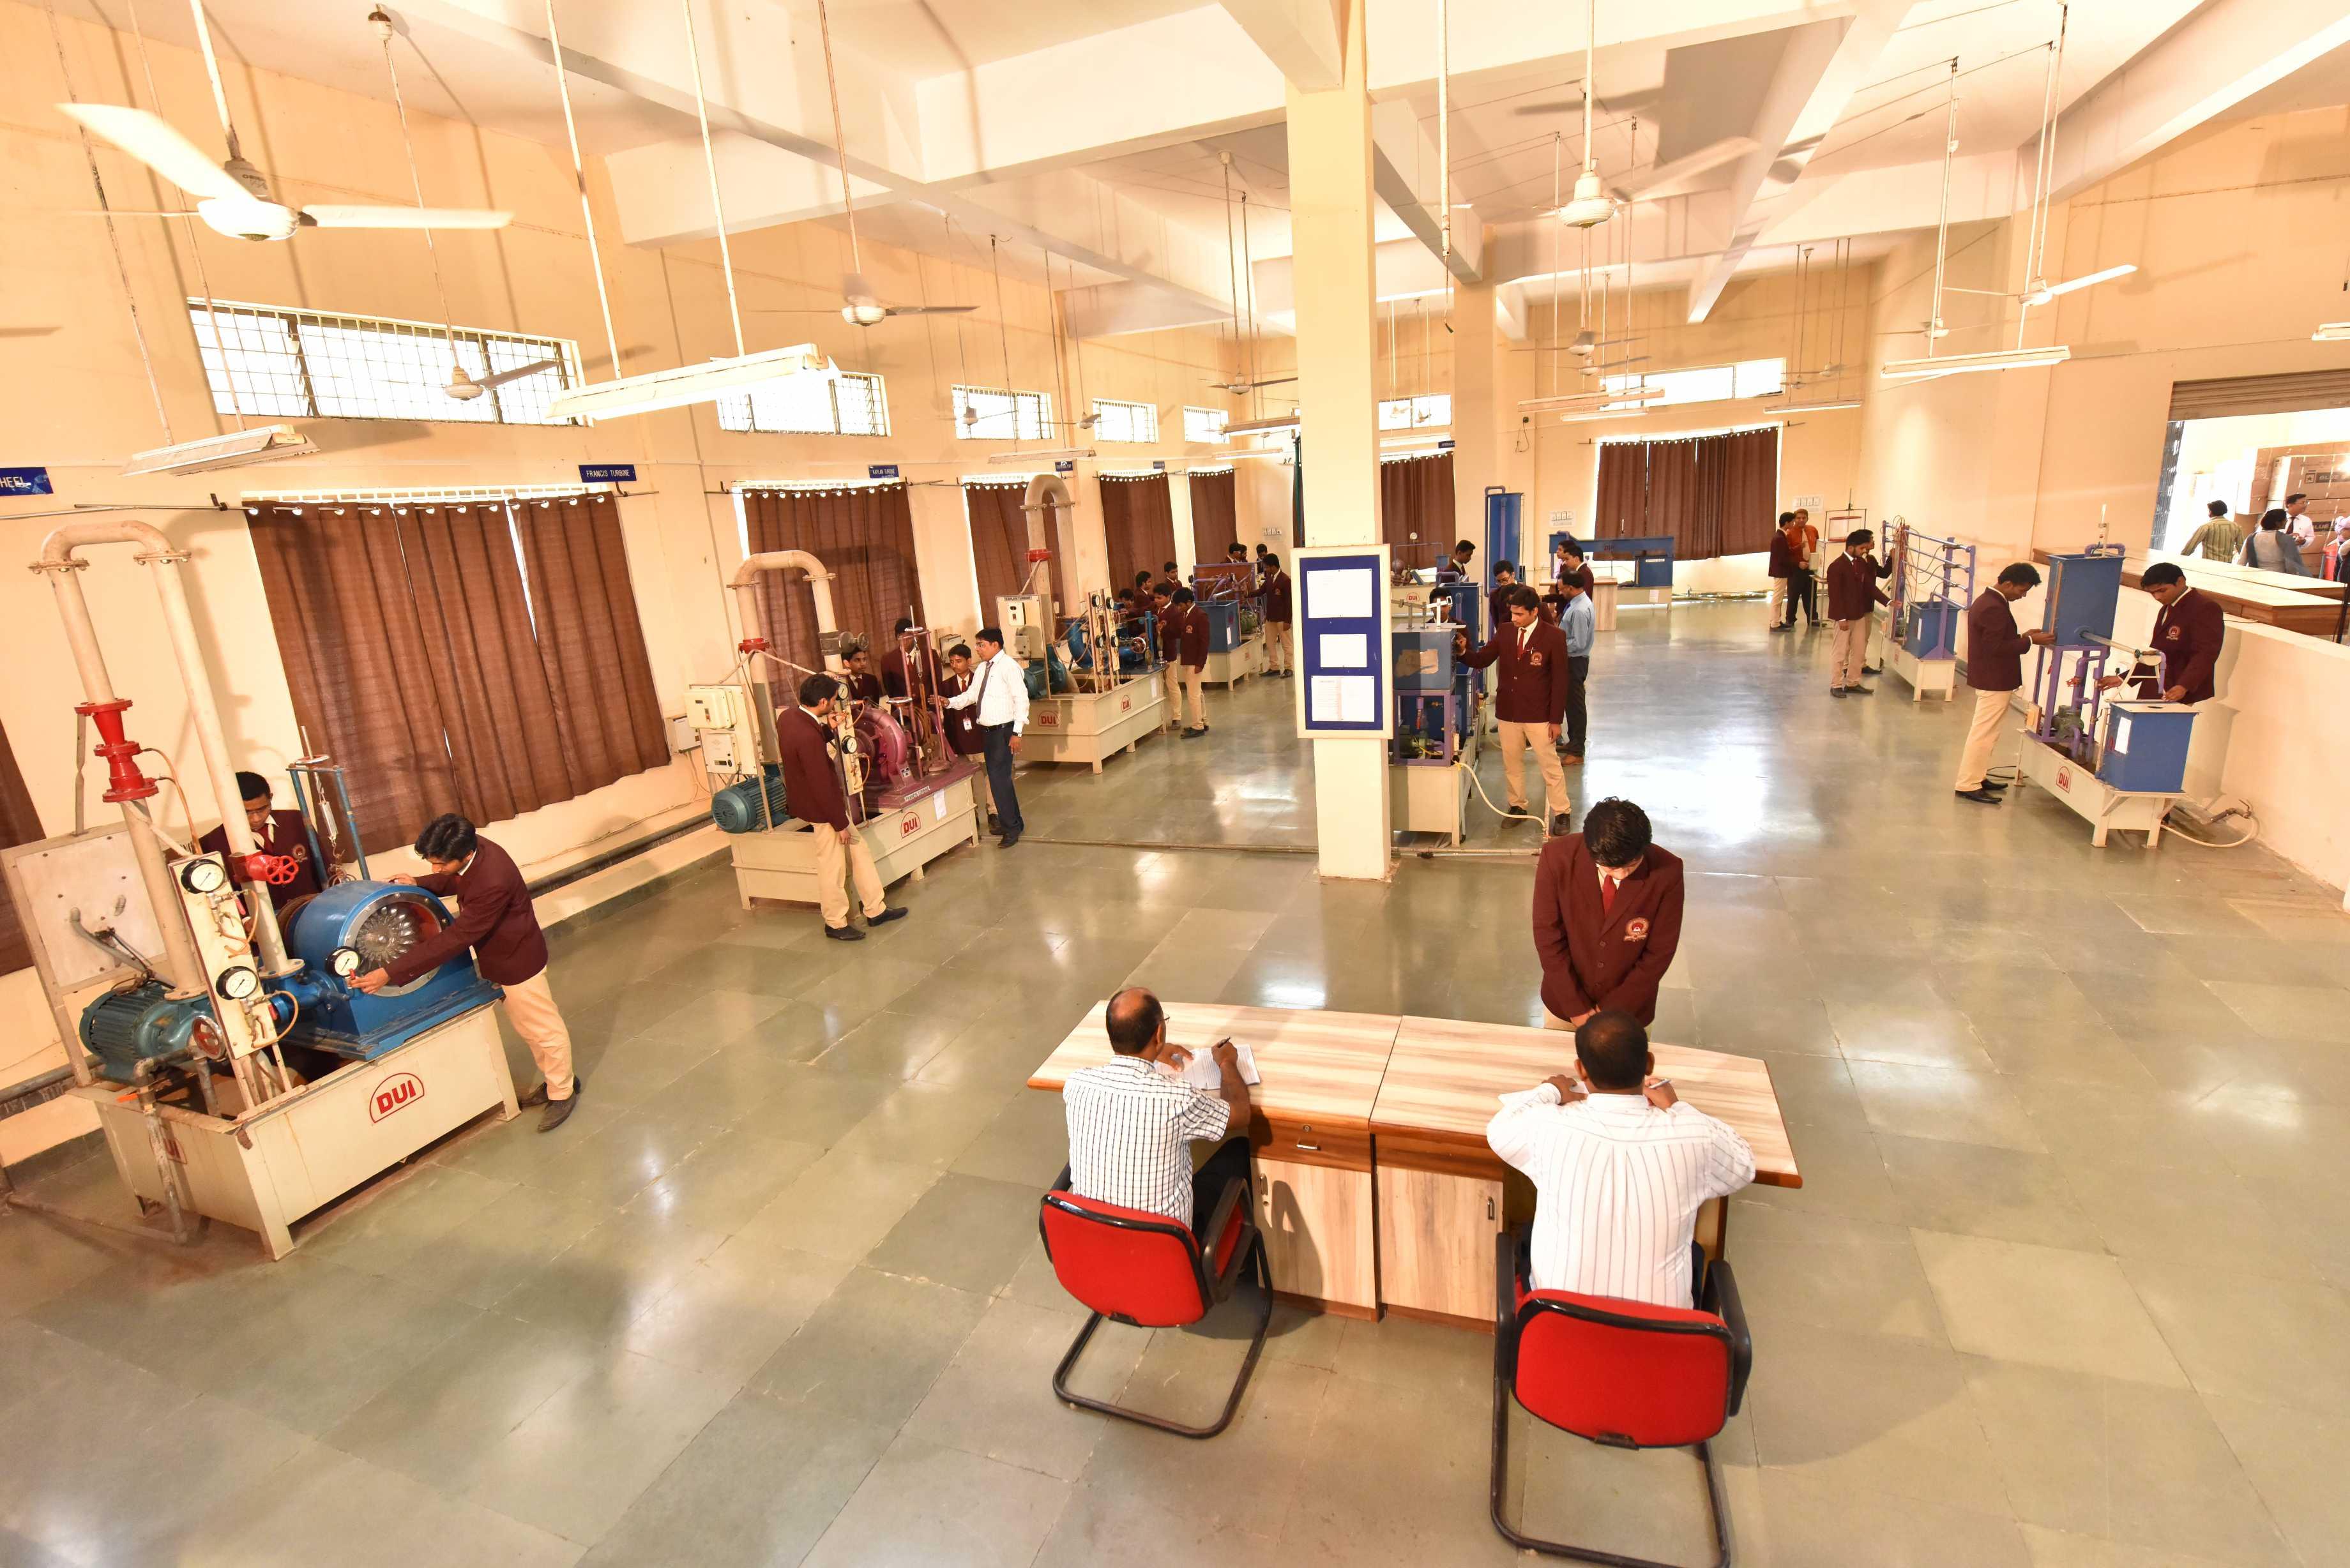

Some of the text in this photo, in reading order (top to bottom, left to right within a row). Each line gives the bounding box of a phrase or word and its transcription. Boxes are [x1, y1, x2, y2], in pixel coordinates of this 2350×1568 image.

[0, 476, 28, 488] HEEL
[1041, 716, 1056, 725] DUI
[2058, 773, 2069, 788] DUI
[903, 817, 918, 834] DUI
[376, 1080, 416, 1114] DUI
[163, 1138, 181, 1159] UI
